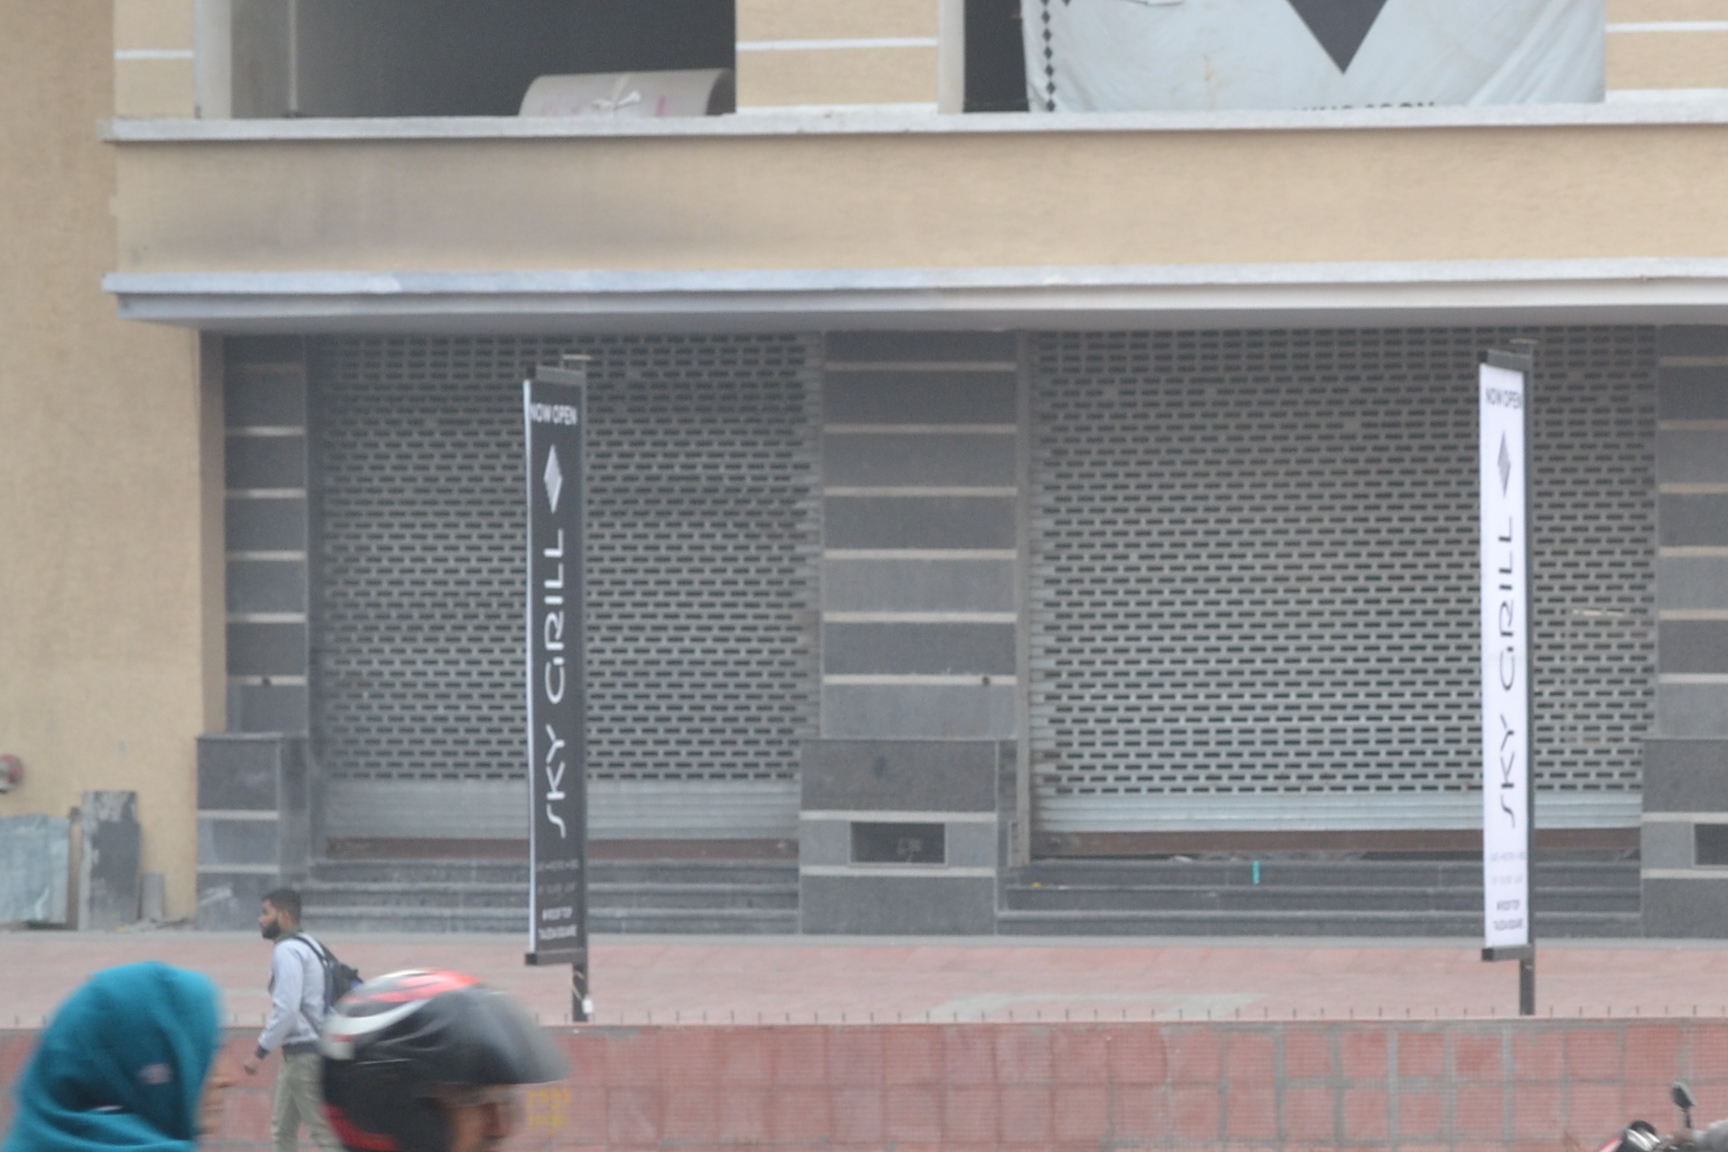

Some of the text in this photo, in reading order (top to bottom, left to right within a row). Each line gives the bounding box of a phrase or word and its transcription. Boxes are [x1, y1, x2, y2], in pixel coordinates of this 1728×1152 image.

[543, 528, 566, 704] GRILL
[1498, 516, 1515, 828] SKY GRILL
[545, 724, 566, 839] SKY
